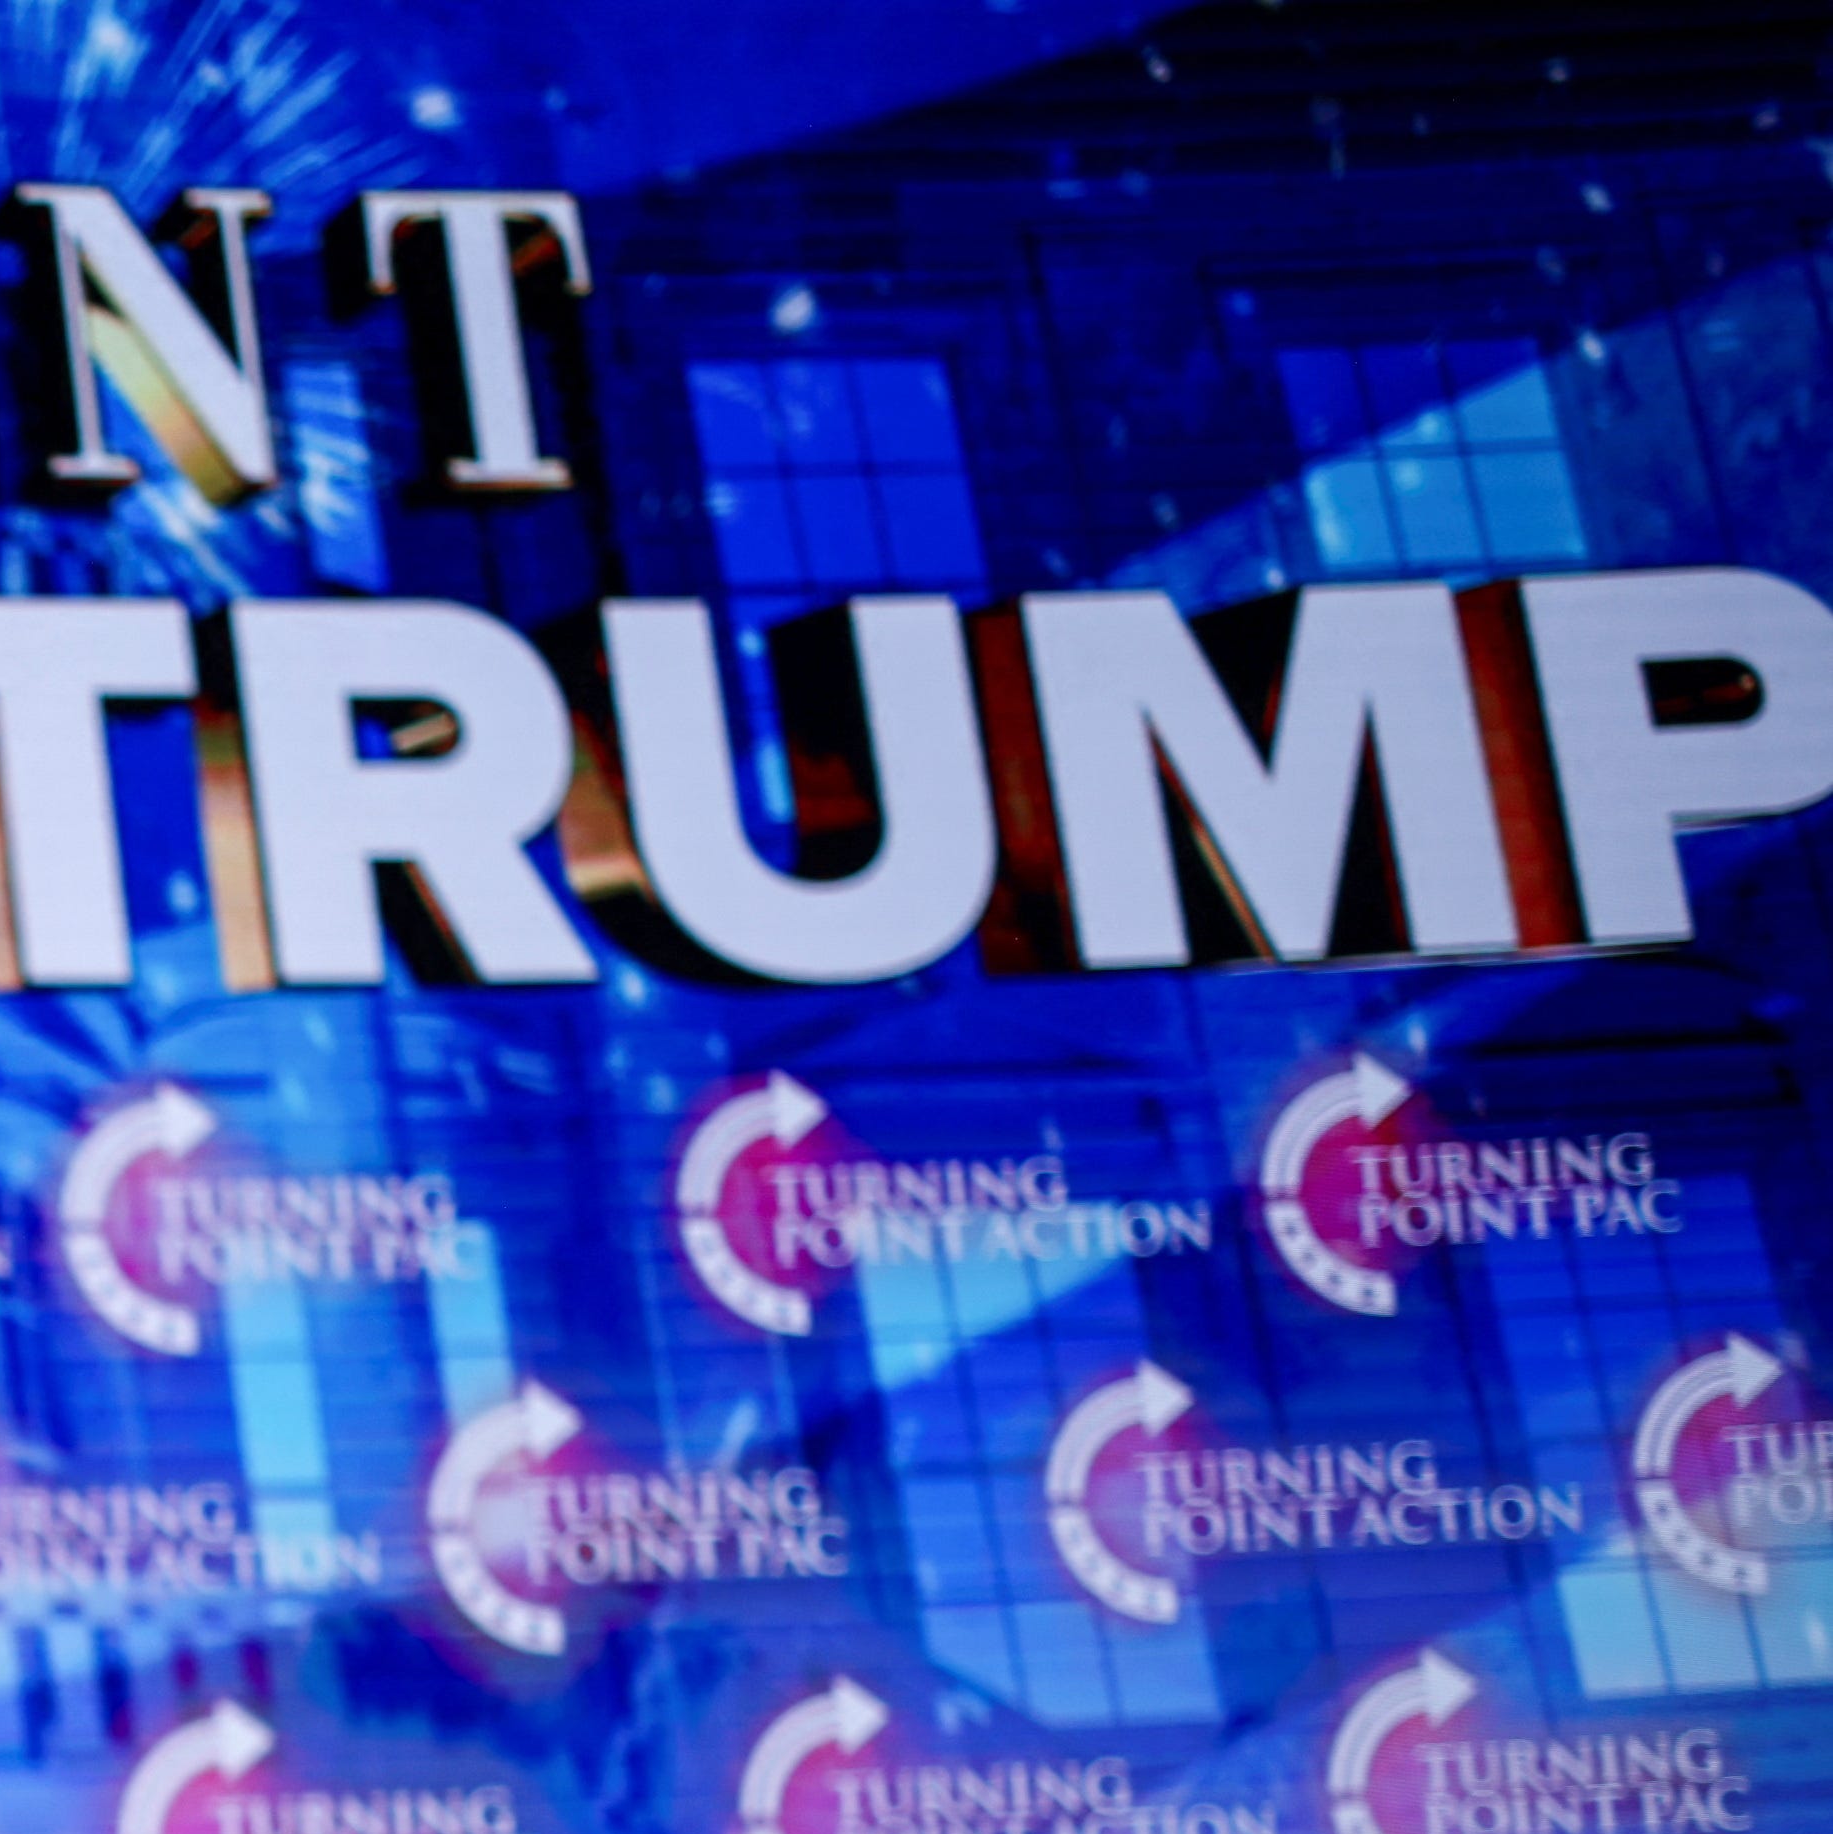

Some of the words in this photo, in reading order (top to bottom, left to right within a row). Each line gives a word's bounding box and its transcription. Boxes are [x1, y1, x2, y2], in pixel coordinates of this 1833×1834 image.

[764, 1155, 1068, 1214] TURNING
[1347, 1133, 1655, 1197] TURNING
[153, 1174, 457, 1230] TURNING
[773, 1209, 973, 1268] POINT
[983, 1199, 1211, 1260] ACTION
[1357, 1187, 1556, 1248] POINT
[1569, 1179, 1683, 1237] PAC
[157, 1229, 357, 1283] POINT
[372, 1221, 490, 1281] PAC
[521, 1467, 821, 1532] TURNING
[1134, 1440, 1437, 1504] TURNING
[527, 1527, 721, 1586] POINT
[737, 1517, 849, 1577] PAC
[1142, 1495, 1342, 1557] POINT
[1351, 1481, 1582, 1546] ACTION
[828, 1757, 1130, 1822] TURNING
[1416, 1728, 1721, 1796] TURNING
